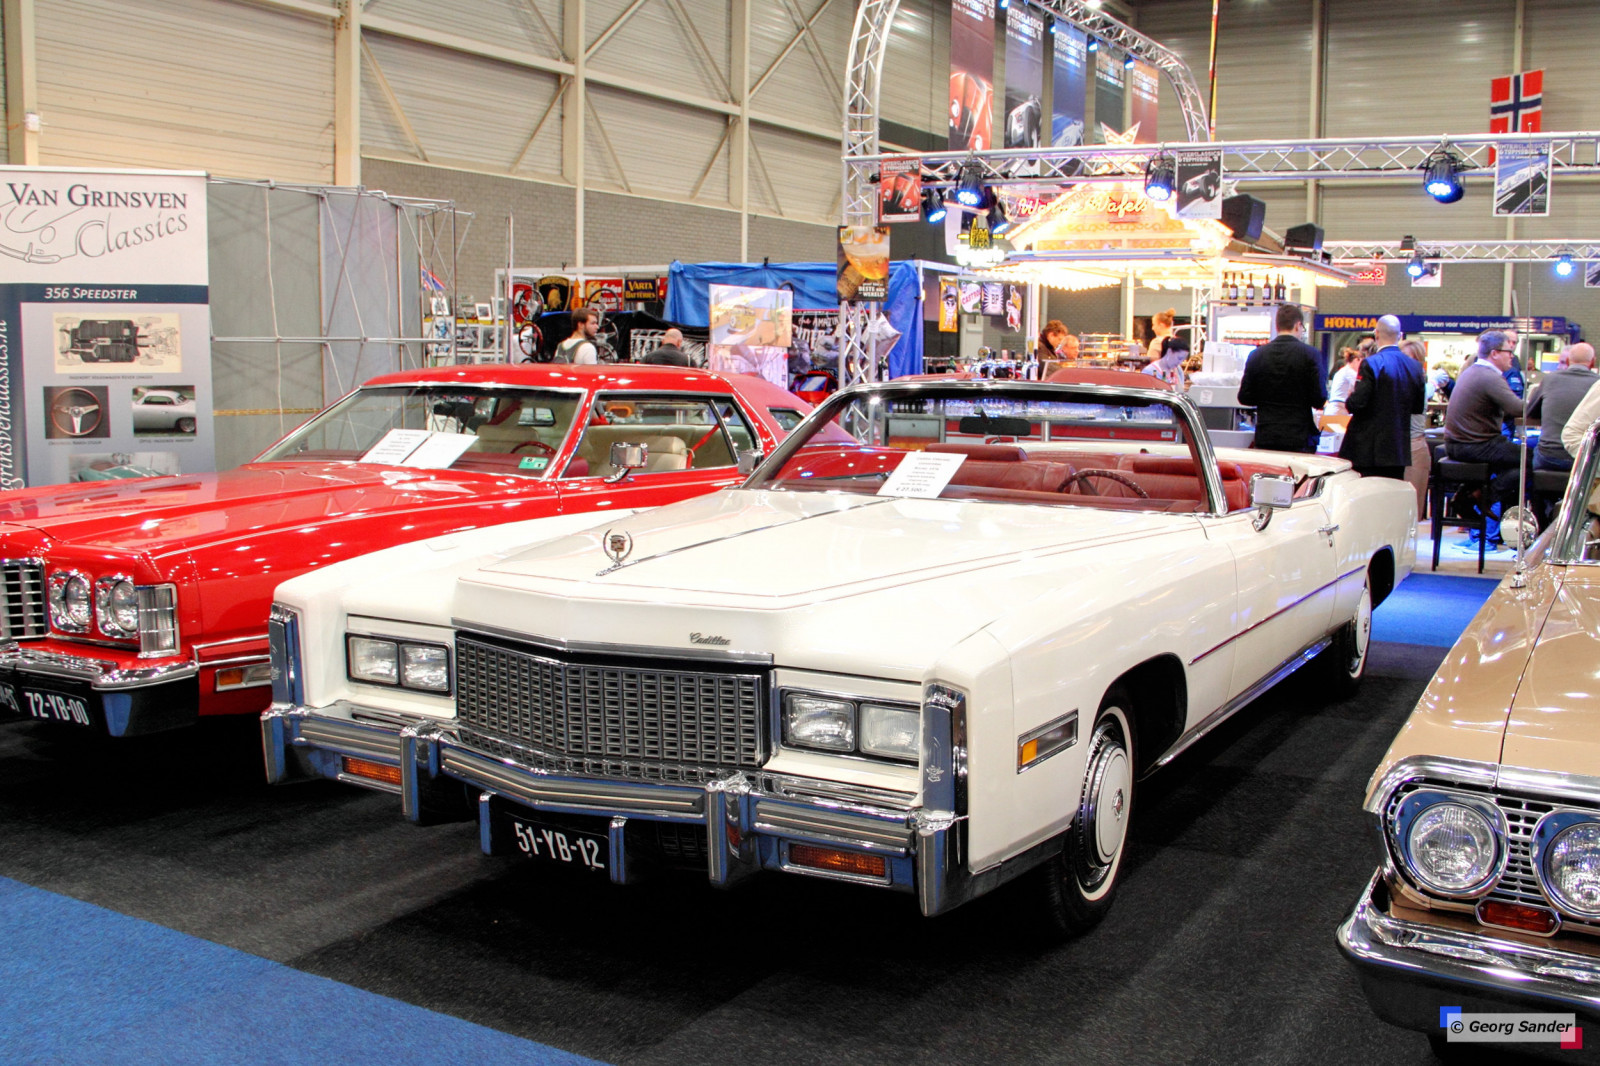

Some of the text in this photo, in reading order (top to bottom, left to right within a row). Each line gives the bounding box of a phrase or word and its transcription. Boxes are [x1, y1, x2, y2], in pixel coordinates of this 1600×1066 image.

[78, 211, 188, 258] Classics
[44, 287, 70, 299] 356
[1324, 316, 1378, 328] HÖRMA
[1423, 320, 1445, 328] Deuren
[1459, 321, 1480, 330] woning
[1488, 321, 1514, 329] industrie
[690, 632, 731, 646] Cadillac
[25, 691, 90, 726] 72-YB-00
[514, 821, 605, 869] 51-YB-12
